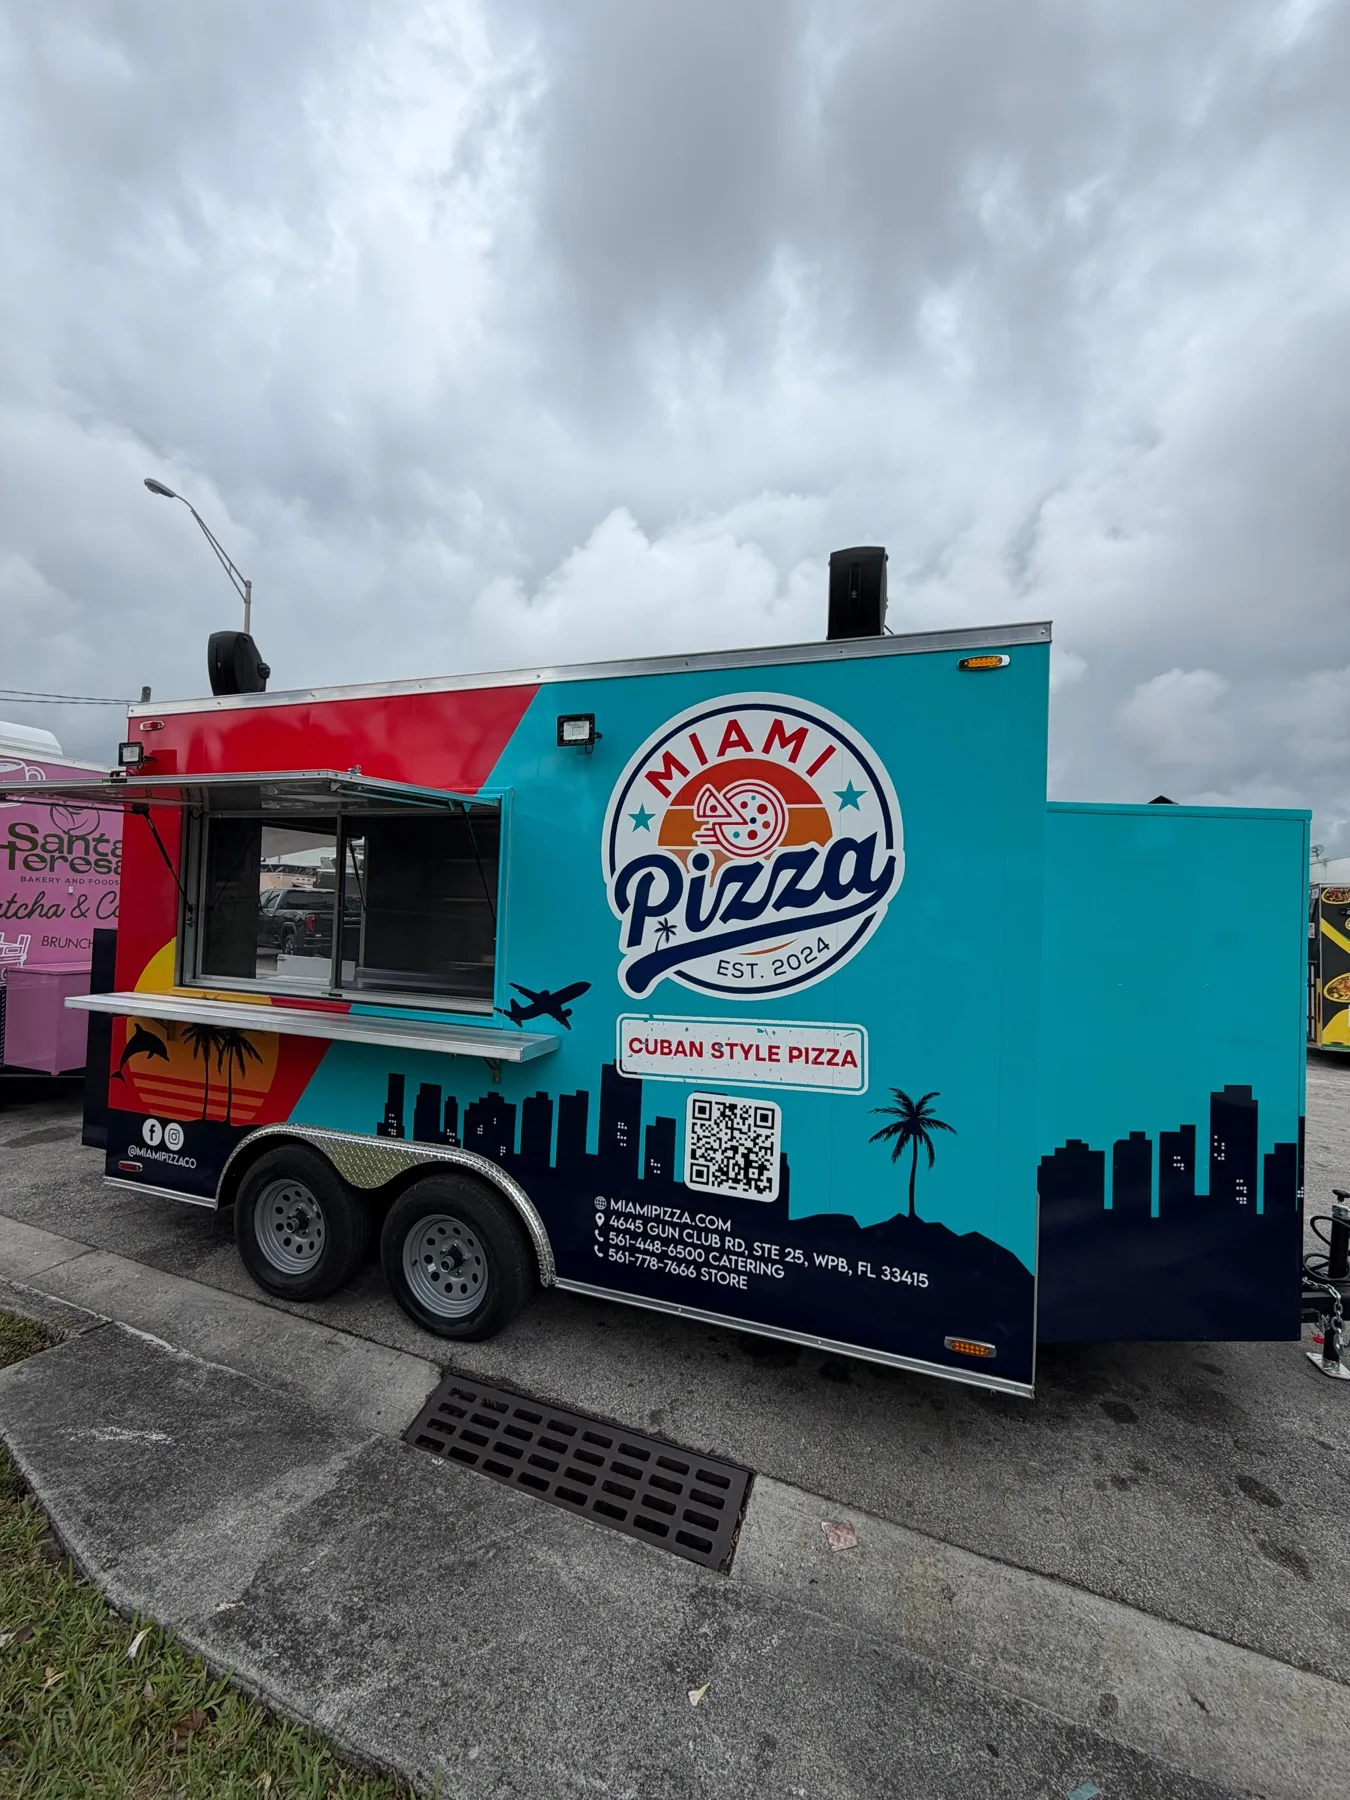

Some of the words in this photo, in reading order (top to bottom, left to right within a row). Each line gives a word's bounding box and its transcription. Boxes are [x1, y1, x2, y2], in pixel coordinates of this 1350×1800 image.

[644, 718, 837, 799] MIAMI
[20, 876, 60, 884] BAKERY
[614, 831, 897, 948] Pizza
[70, 894, 90, 919] &
[716, 959, 765, 979] EST.
[771, 936, 831, 977] 2024
[628, 1037, 703, 1058] CUBAN
[711, 1042, 781, 1063] STYLE
[788, 1047, 858, 1068] PIZZA
[127, 1144, 197, 1169] @MIAMIPIZZACO
[610, 1198, 732, 1232] MIAMIPIZZA.COM
[608, 1231, 705, 1262] 561-448-6500
[709, 1252, 785, 1279] CATERING
[608, 1248, 697, 1278] 561-778-7666
[700, 1267, 748, 1289] STORE
[609, 1215, 643, 1233] 4645
[647, 1222, 679, 1240] GUN
[683, 1229, 721, 1248] CLUB
[725, 1236, 748, 1256] RD,
[753, 1242, 780, 1260] STE
[784, 1247, 809, 1268] 25,
[813, 1252, 853, 1276] WPB,
[857, 1261, 876, 1279] FL
[881, 1265, 929, 1288] 33415
